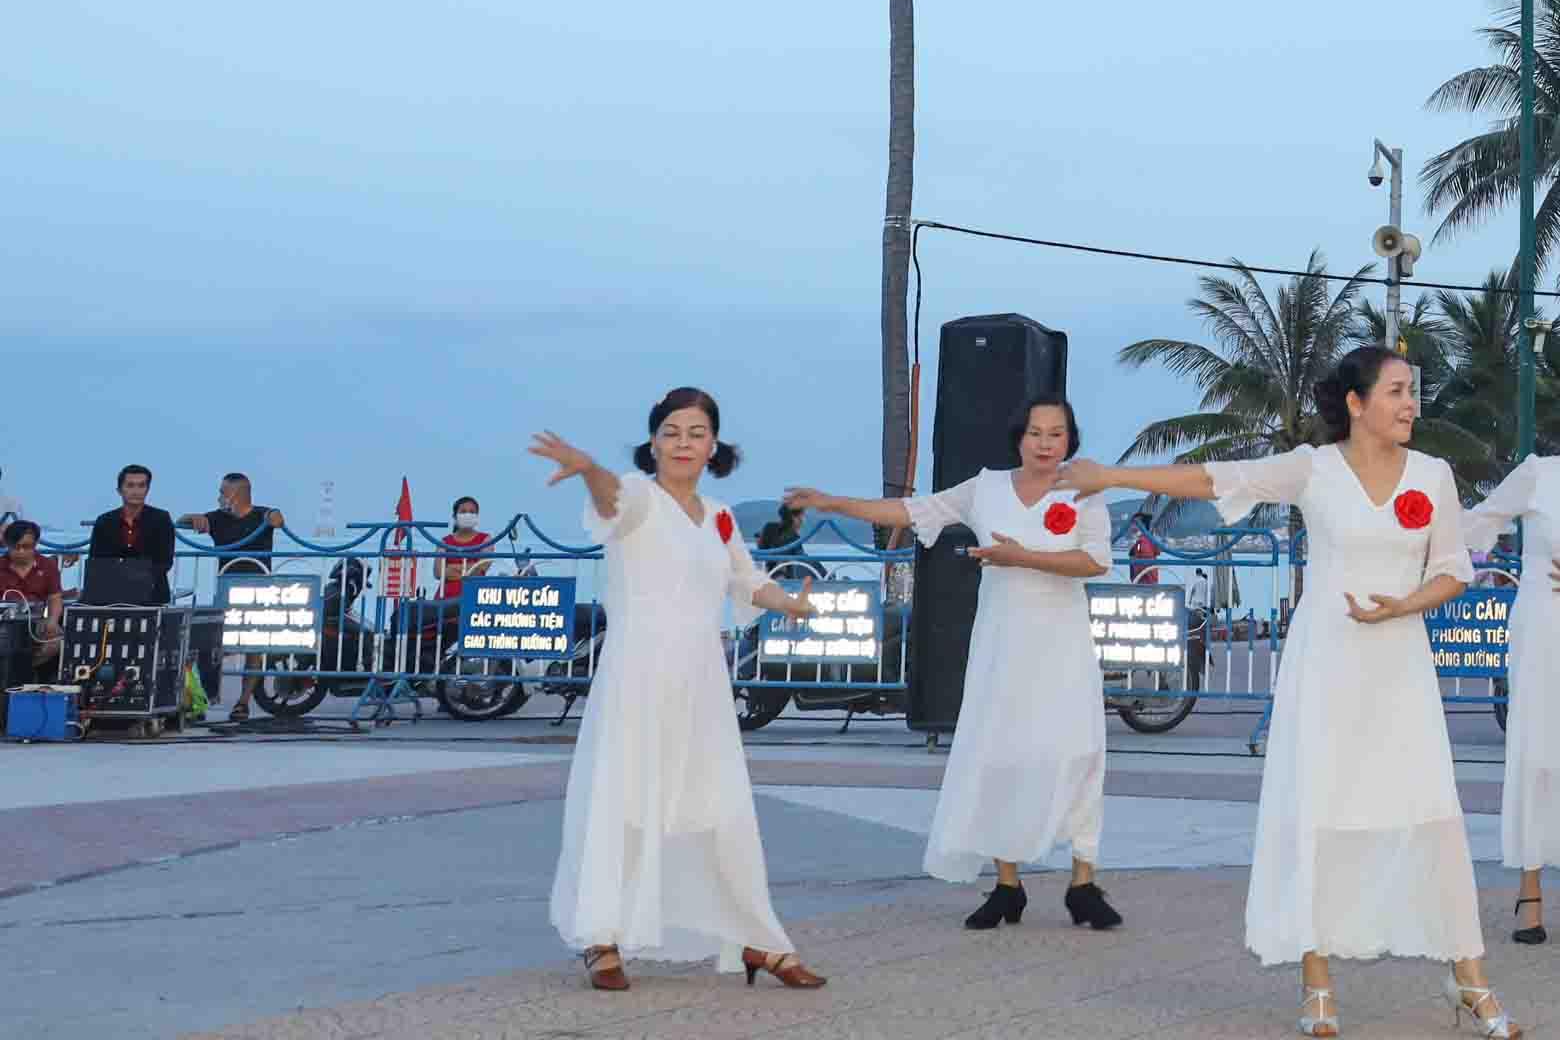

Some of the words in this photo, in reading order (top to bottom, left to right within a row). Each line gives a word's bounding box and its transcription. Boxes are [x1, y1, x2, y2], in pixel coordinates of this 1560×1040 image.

[477, 587, 502, 605] KHU
[505, 587, 529, 608] VỰC
[532, 585, 560, 607] CẤM
[1444, 600, 1471, 622] VỰC
[1476, 597, 1507, 620] CẤM
[470, 611, 491, 627] CÁC
[539, 612, 564, 631] TIỆN
[464, 634, 485, 649] GIAO
[1432, 627, 1481, 643] PHƯƠNG
